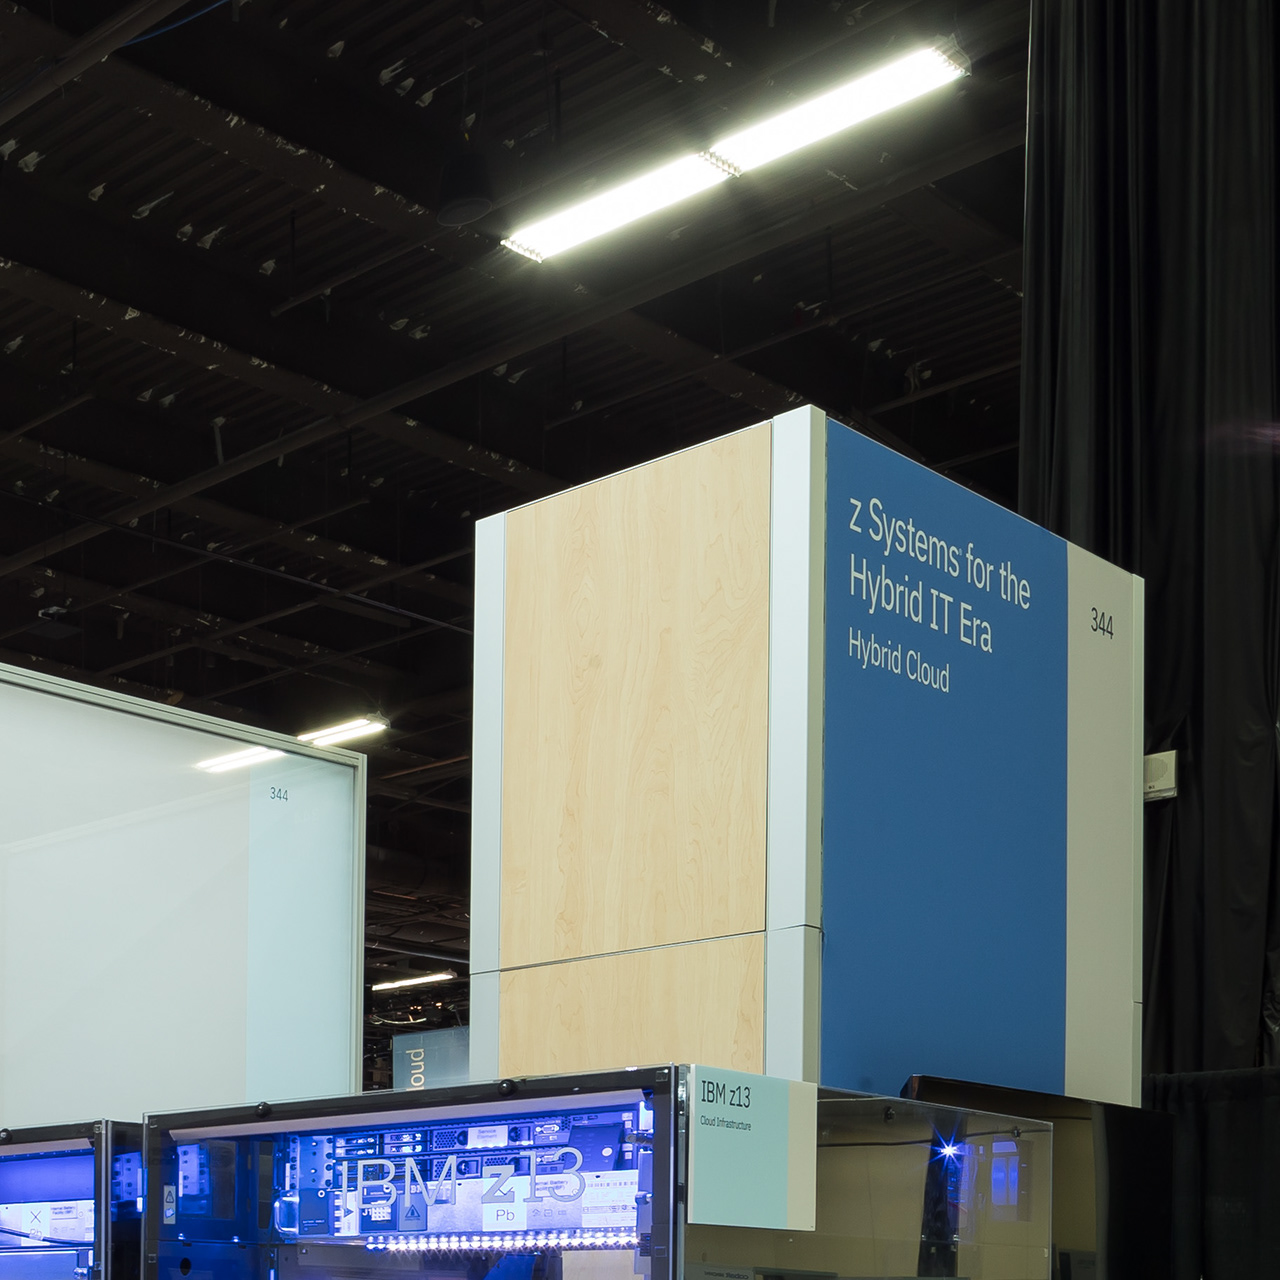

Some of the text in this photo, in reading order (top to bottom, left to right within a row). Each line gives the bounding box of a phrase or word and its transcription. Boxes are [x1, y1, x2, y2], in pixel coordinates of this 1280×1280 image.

[849, 497, 1031, 610] z Systems for the
[850, 553, 993, 653] Hybrid IT Era
[1091, 606, 1114, 640] 344
[848, 626, 950, 693] Hybrid Cloud
[270, 786, 289, 803] 344
[701, 1080, 751, 1108] IBM z13
[700, 1115, 751, 1131] Cloud Infrastructure
[342, 1147, 586, 1209] IBM z13
[496, 1208, 515, 1222] Pb
